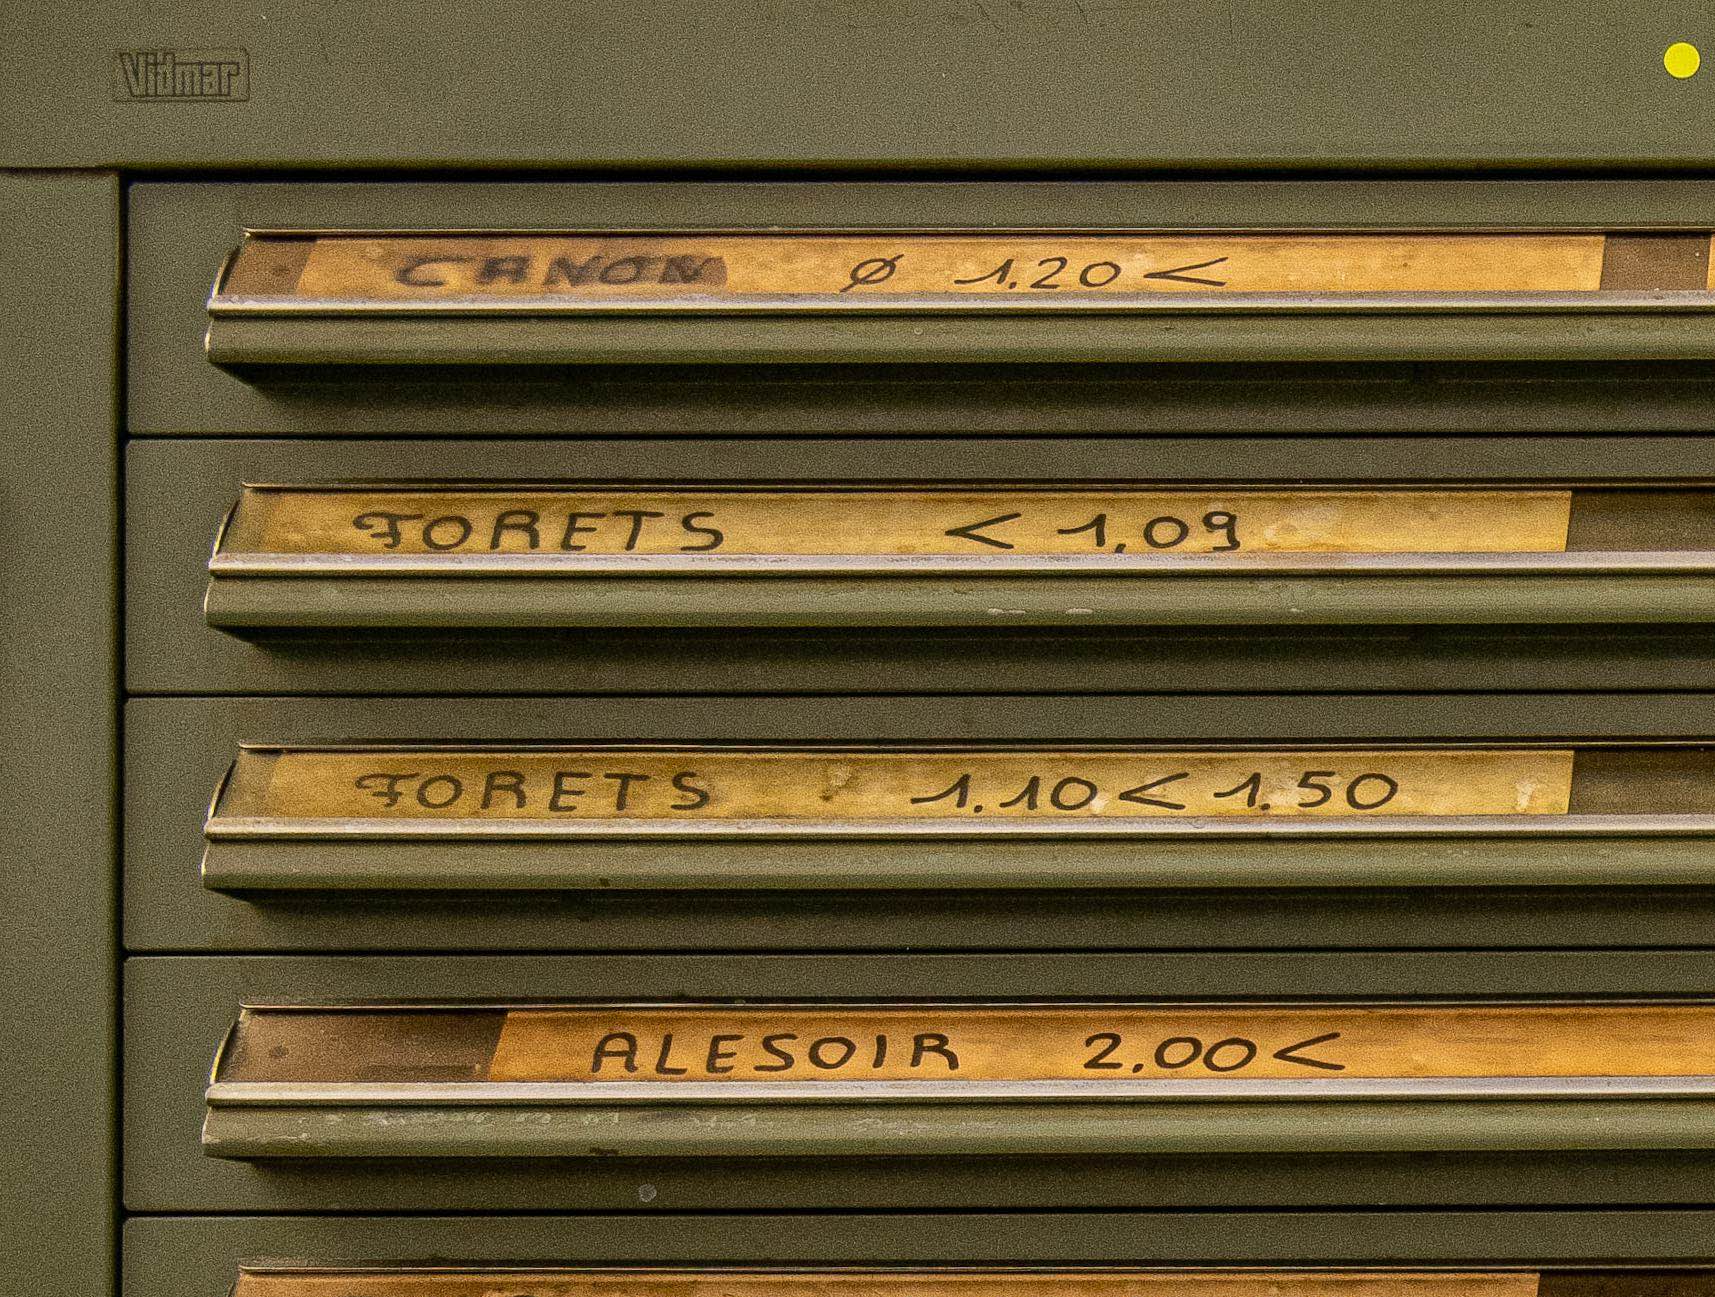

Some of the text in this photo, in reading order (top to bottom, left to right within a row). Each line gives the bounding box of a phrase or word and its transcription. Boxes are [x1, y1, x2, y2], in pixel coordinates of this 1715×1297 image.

[352, 509, 725, 552] FORETS
[354, 770, 713, 812] FORETS
[591, 1031, 960, 1076] ALESOIR
